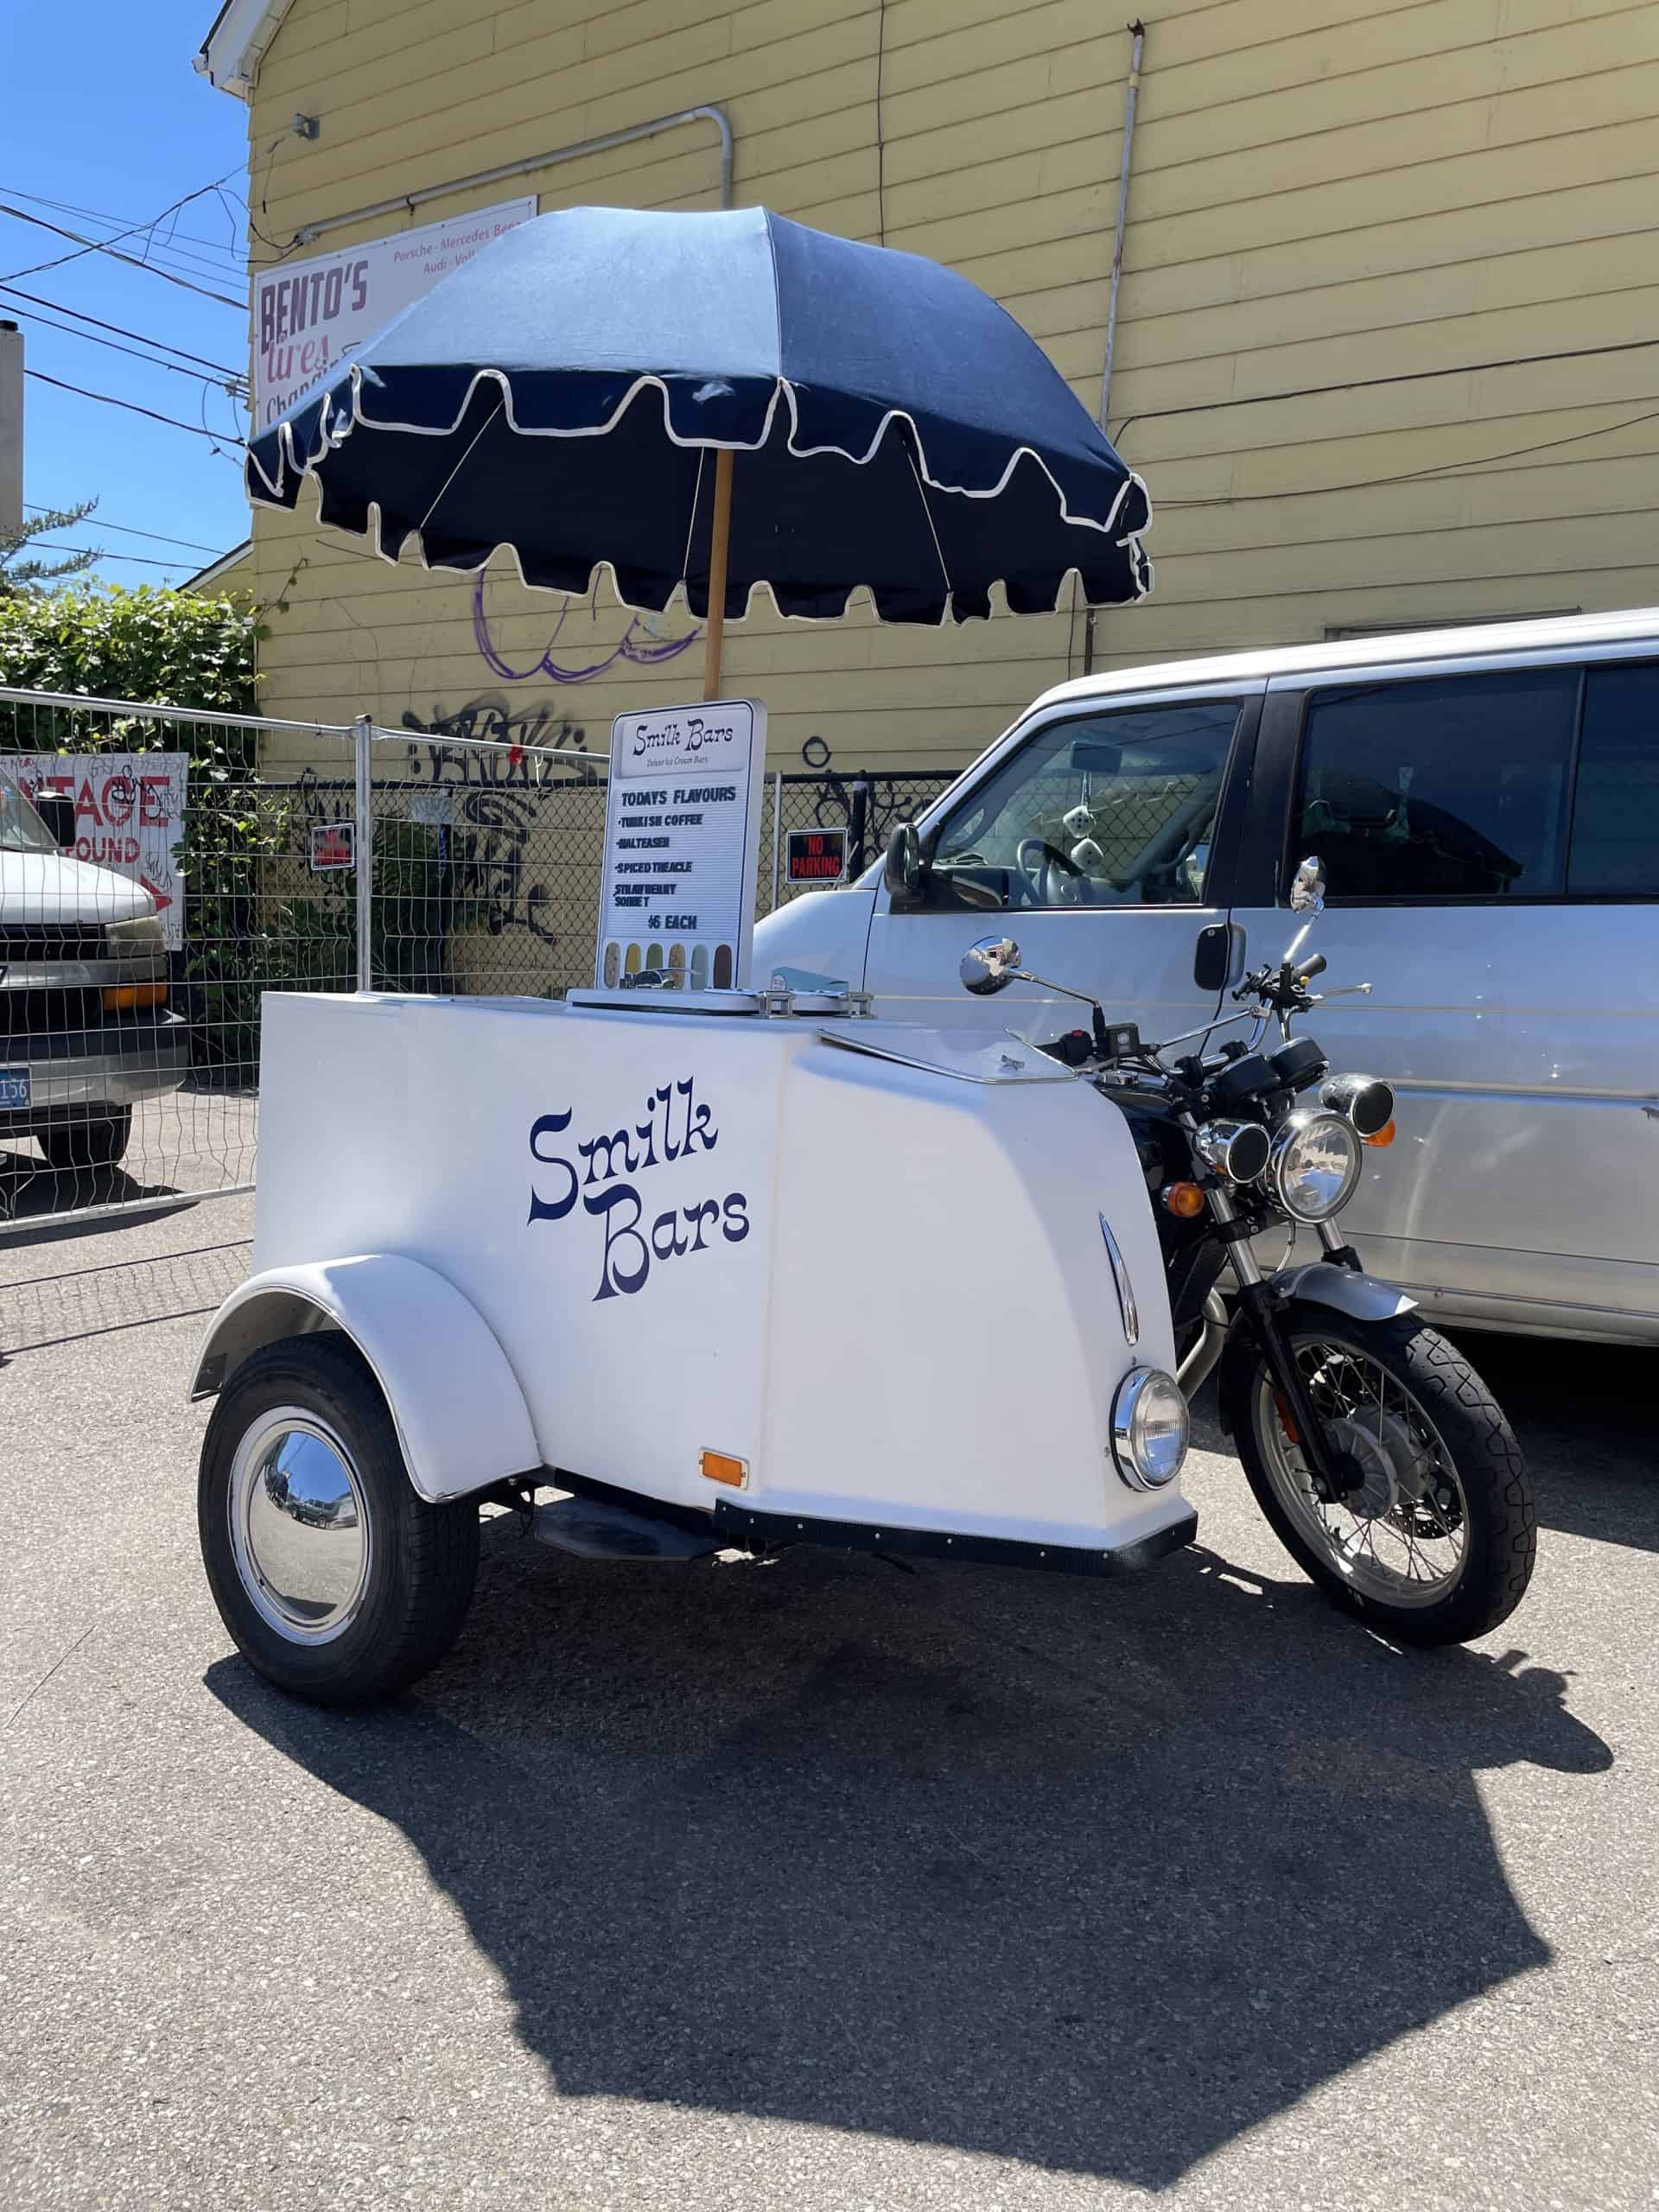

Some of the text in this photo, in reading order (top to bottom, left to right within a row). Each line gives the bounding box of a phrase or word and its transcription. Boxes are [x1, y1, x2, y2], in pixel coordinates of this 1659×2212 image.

[394, 244, 433, 264] Porsche
[423, 257, 448, 276] Audi
[261, 260, 369, 355] BENTO'S
[632, 718, 734, 756] Smilk Bars
[673, 785, 737, 804] FLAVOURS
[664, 813, 704, 826] COFFEE
[808, 835, 823, 855] NO
[791, 855, 841, 877] PARKING
[648, 914, 697, 931] $6 EACH
[526, 1076, 719, 1226] Smilk
[582, 1183, 750, 1301] Bars
